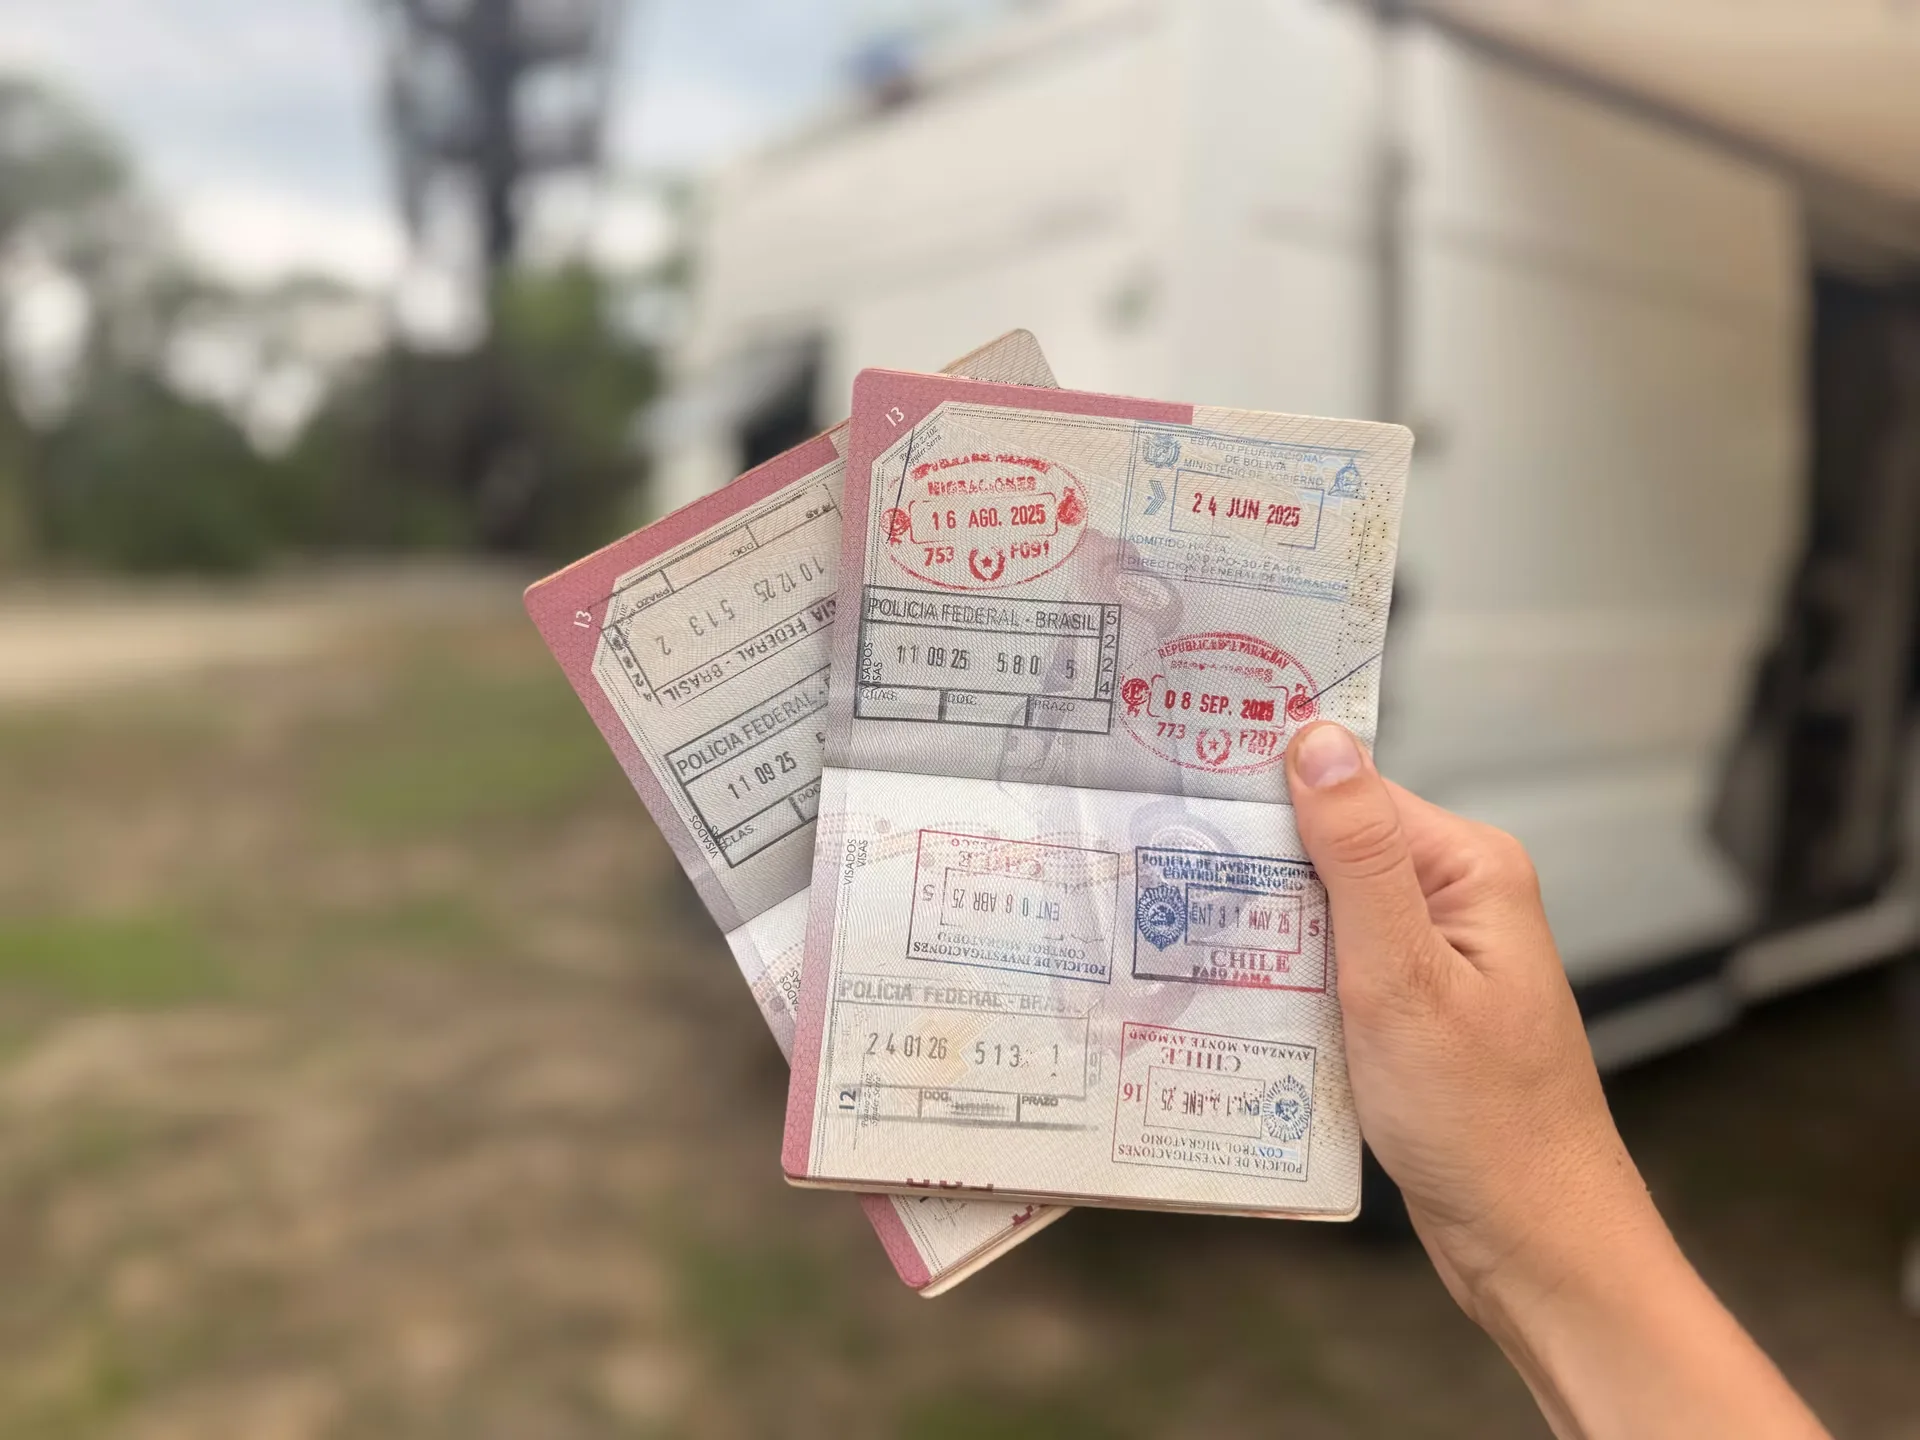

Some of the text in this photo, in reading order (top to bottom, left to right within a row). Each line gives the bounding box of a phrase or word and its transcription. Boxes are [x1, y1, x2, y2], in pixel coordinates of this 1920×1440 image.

[885, 406, 905, 427] 13
[1190, 436, 1234, 454] ESTADO
[1183, 458, 1246, 479] MINISTERIO
[1225, 454, 1287, 472] DE BOLIVIA
[968, 507, 1003, 529] AGO.
[1010, 503, 1047, 526] 2025
[1226, 496, 1260, 521] JUN
[1266, 503, 1302, 528] 2025
[924, 546, 955, 567] 753
[573, 609, 593, 629] 13
[941, 603, 1019, 627] FEDERAL
[1035, 610, 1096, 631] BRASIL
[738, 617, 808, 662] FEDERAL
[1238, 640, 1290, 670] PARAGUAY
[662, 663, 723, 702] BRASIL
[741, 690, 818, 742] FEDERAL
[1034, 699, 1076, 713] PRAZO
[1199, 695, 1233, 717] SEP.
[1156, 721, 1186, 740] 773
[754, 762, 776, 785] 09
[775, 751, 798, 774] 25
[689, 814, 718, 859] VISADOS
[843, 837, 858, 886] VISADOS
[856, 838, 869, 868] VISAS
[1141, 853, 1193, 870] POLICIA
[1196, 857, 1212, 870] DE
[952, 888, 966, 909] 25
[972, 890, 998, 913] ABR
[1035, 899, 1061, 922] ENT
[1191, 902, 1213, 926] ENT
[1249, 909, 1273, 934] MAY
[1308, 919, 1321, 937] 5
[912, 941, 1031, 968] INVESTIGACIONES
[1210, 949, 1291, 974] CHILE
[1055, 958, 1106, 976] POLICIA
[923, 985, 1008, 1008] FEDERAL
[1190, 1036, 1239, 1053] MONTE
[1242, 1040, 1311, 1062] AVANZADA
[838, 1090, 857, 1111] 12
[1021, 1095, 1060, 1108] PRAZO
[1122, 1082, 1144, 1103] 16
[1182, 1090, 1204, 1118] ENE
[1141, 1132, 1284, 1160] CONTROL MIGRATORIO
[1118, 1143, 1303, 1175] POLICIA DE INVESTIGACIONES
